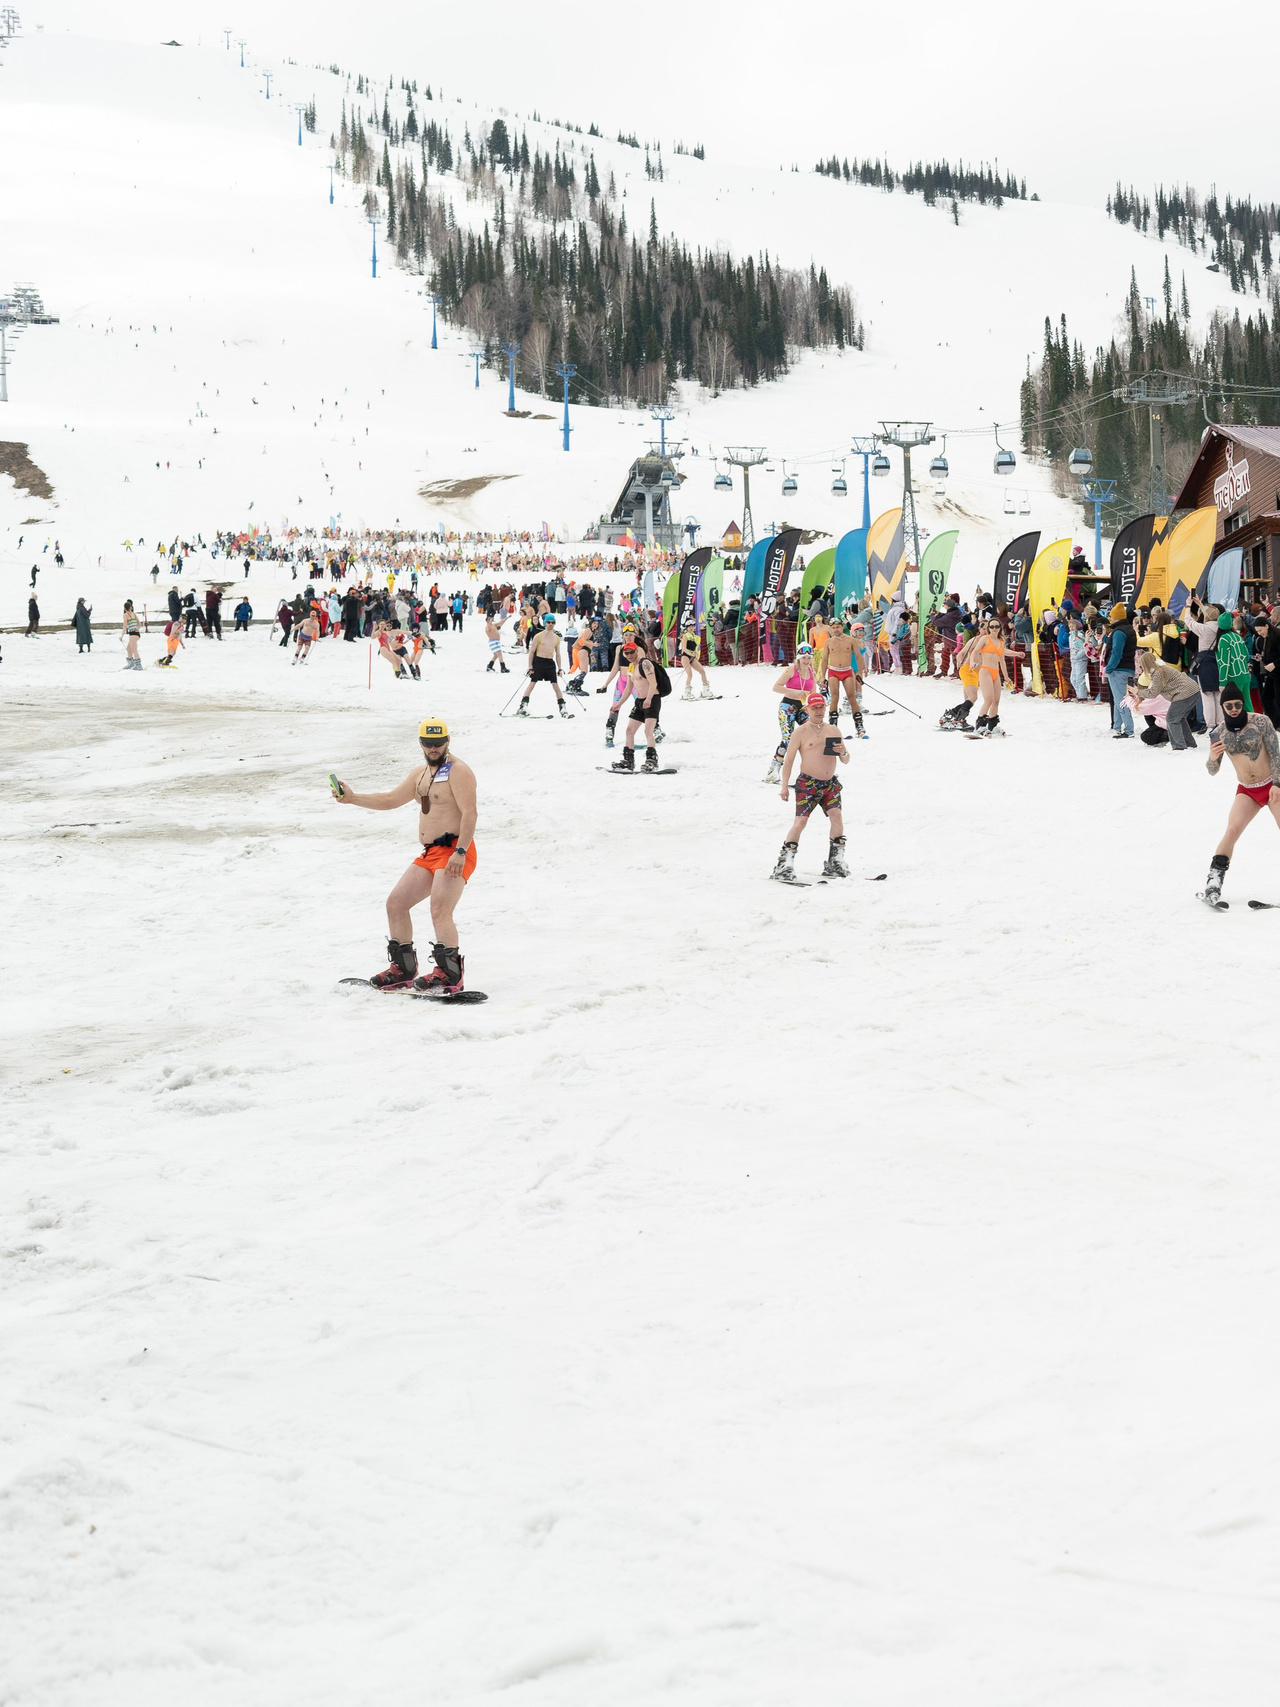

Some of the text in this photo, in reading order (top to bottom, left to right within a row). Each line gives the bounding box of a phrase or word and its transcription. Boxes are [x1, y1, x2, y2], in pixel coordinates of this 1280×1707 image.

[685, 565, 701, 604] HOTELS
[767, 548, 785, 592] HOTELS
[1121, 547, 1136, 605] HOTELS
